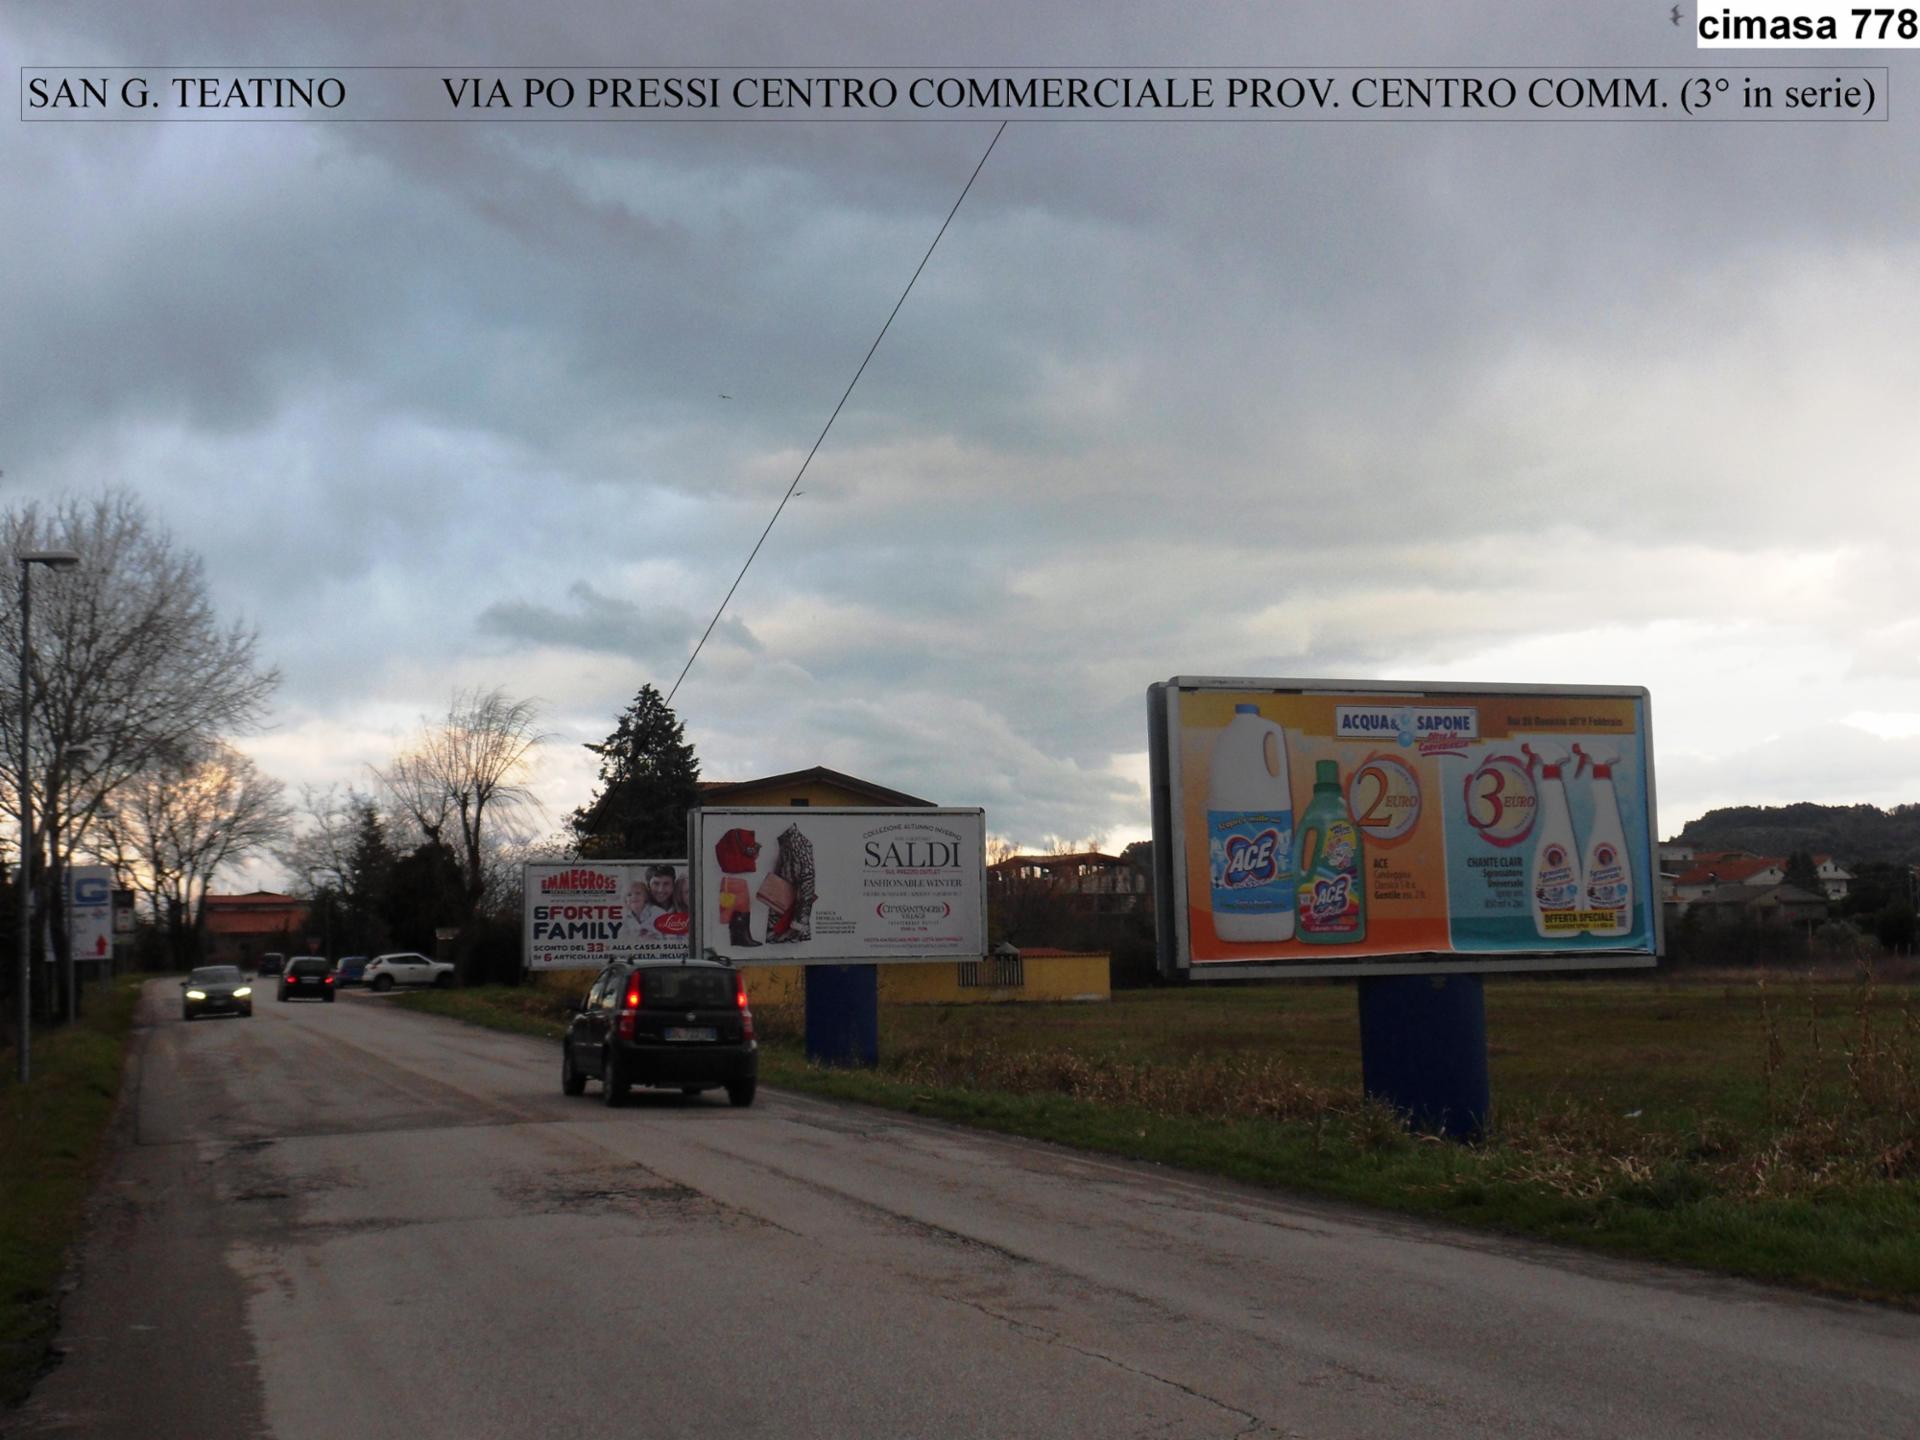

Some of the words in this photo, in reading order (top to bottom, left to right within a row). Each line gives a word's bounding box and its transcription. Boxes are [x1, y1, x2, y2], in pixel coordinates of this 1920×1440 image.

[1417, 715, 1470, 731] SAPONE
[1357, 766, 1393, 827] 2
[1385, 795, 1418, 808] EURO
[1472, 767, 1505, 829] 3
[1504, 795, 1536, 808] EURO
[935, 827, 962, 841] INVERNO
[864, 841, 961, 868] SALDI
[1229, 841, 1274, 874] ACE
[1467, 857, 1498, 867] CHANTE
[1499, 857, 1523, 867] CLAIR
[1373, 858, 1388, 869] ACE
[541, 868, 617, 890] EMMEGROSS
[863, 878, 926, 888] FASHIONABLE
[926, 878, 962, 888] WINTER
[1316, 883, 1346, 905] ACE
[1544, 912, 1577, 923] OFFERTA
[1579, 912, 1614, 923] SPECIALE
[533, 922, 623, 940] FAMILY
[533, 944, 568, 952] SCONTO
[570, 944, 585, 952] DEL
[633, 943, 662, 951] CASSA
[544, 953, 552, 962] 6
